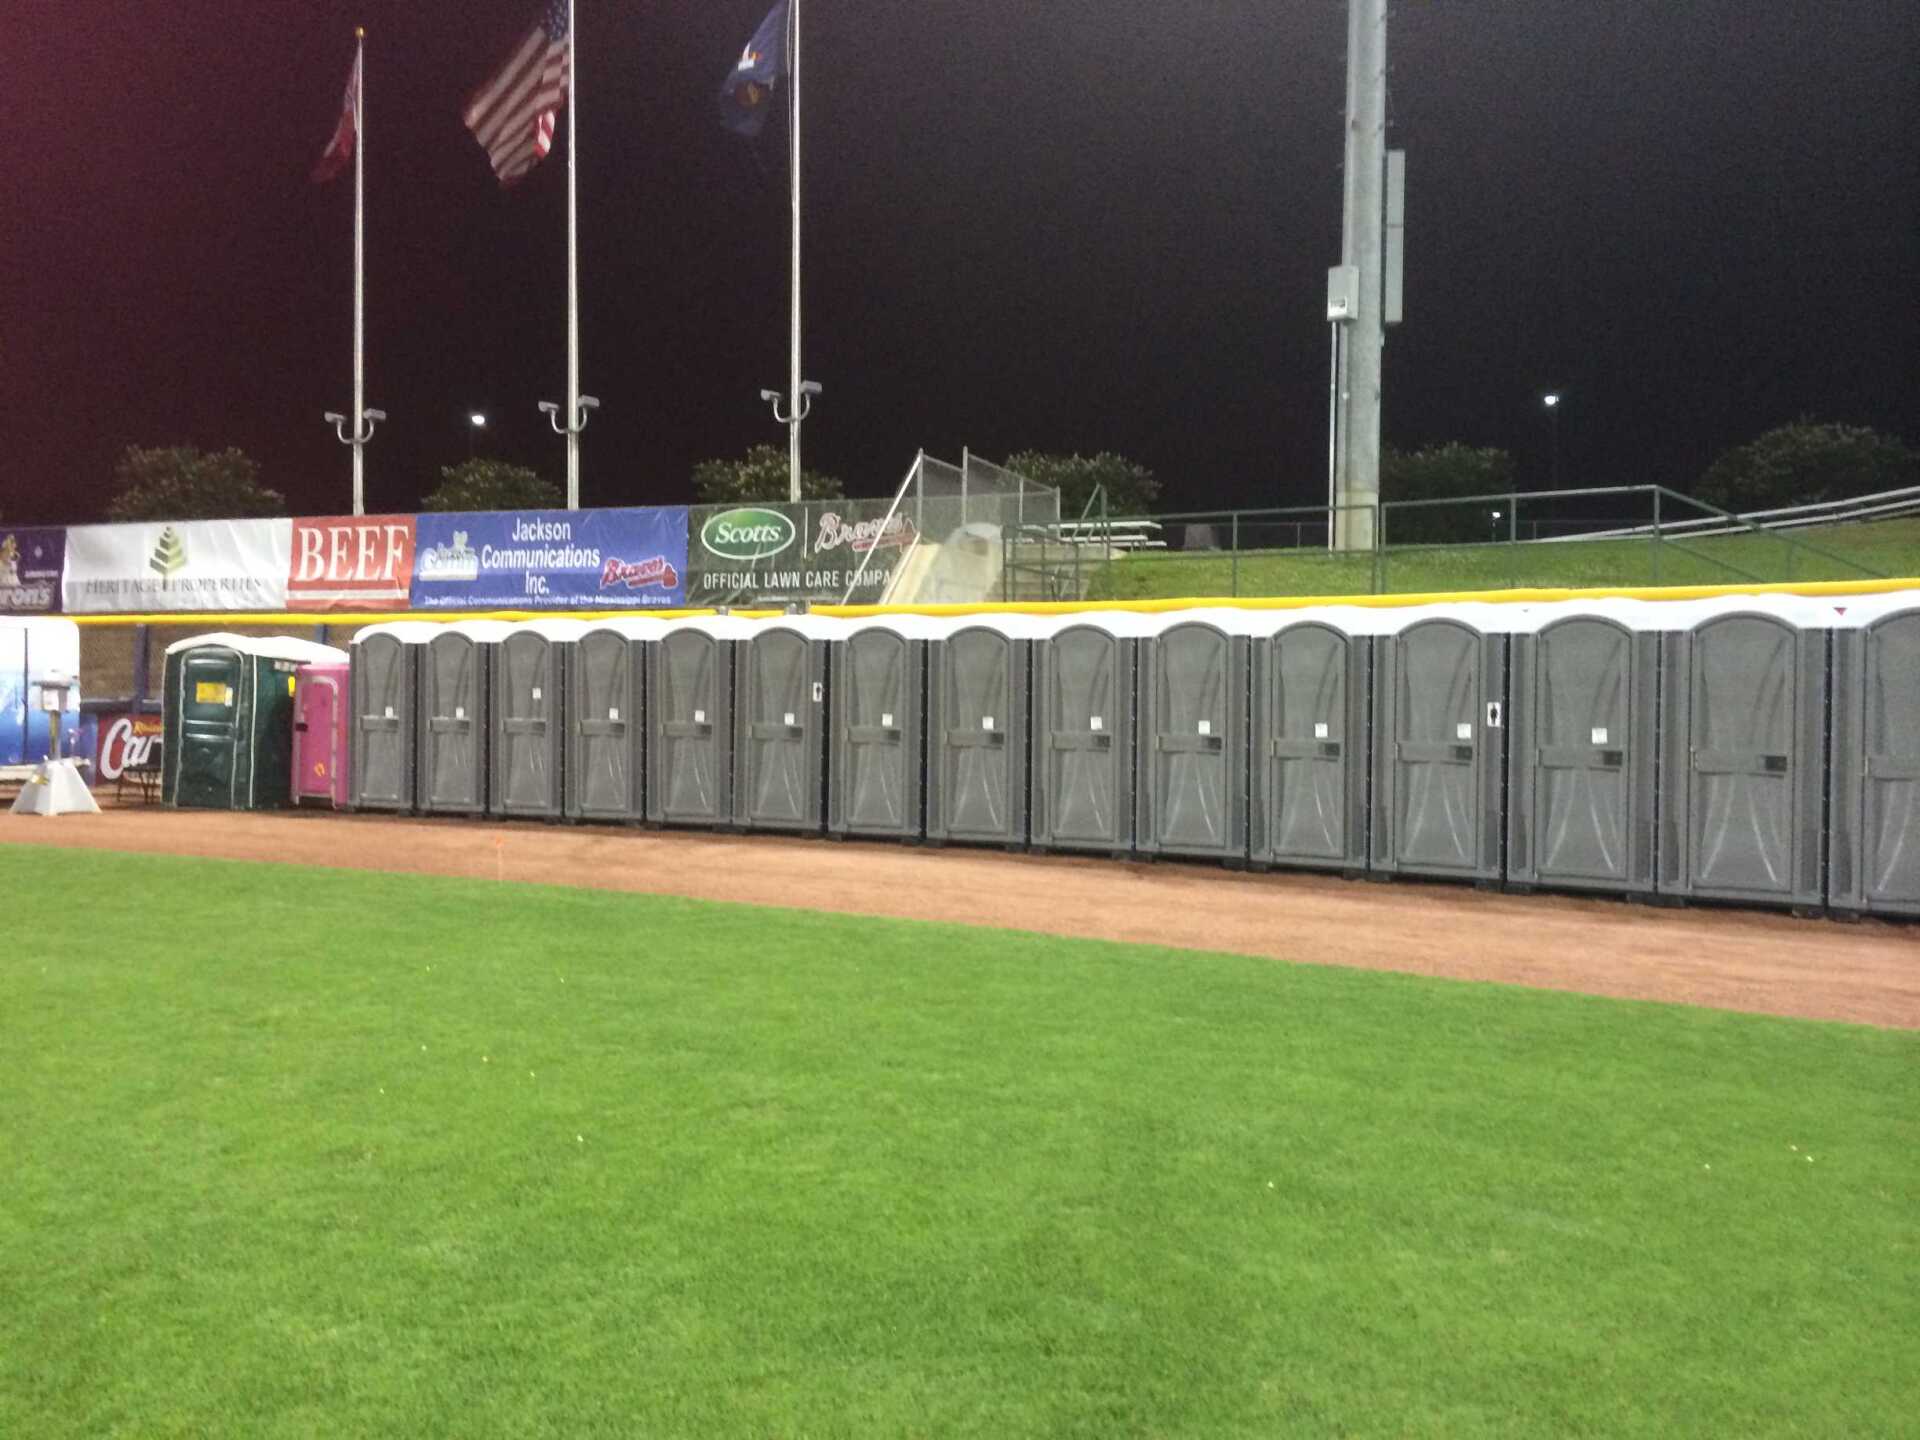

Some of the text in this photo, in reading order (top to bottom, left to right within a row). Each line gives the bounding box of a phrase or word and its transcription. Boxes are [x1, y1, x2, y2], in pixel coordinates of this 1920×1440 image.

[512, 517, 571, 542] Jackson
[715, 521, 782, 545] Scotts
[295, 526, 409, 582] BEEF
[481, 544, 600, 569] Communications
[85, 576, 262, 594] HERITAGE PROPERTIES
[525, 570, 550, 594] Inc.
[703, 571, 760, 590] OFFICIAL
[764, 570, 800, 589] LAWN
[805, 569, 840, 588] CARE
